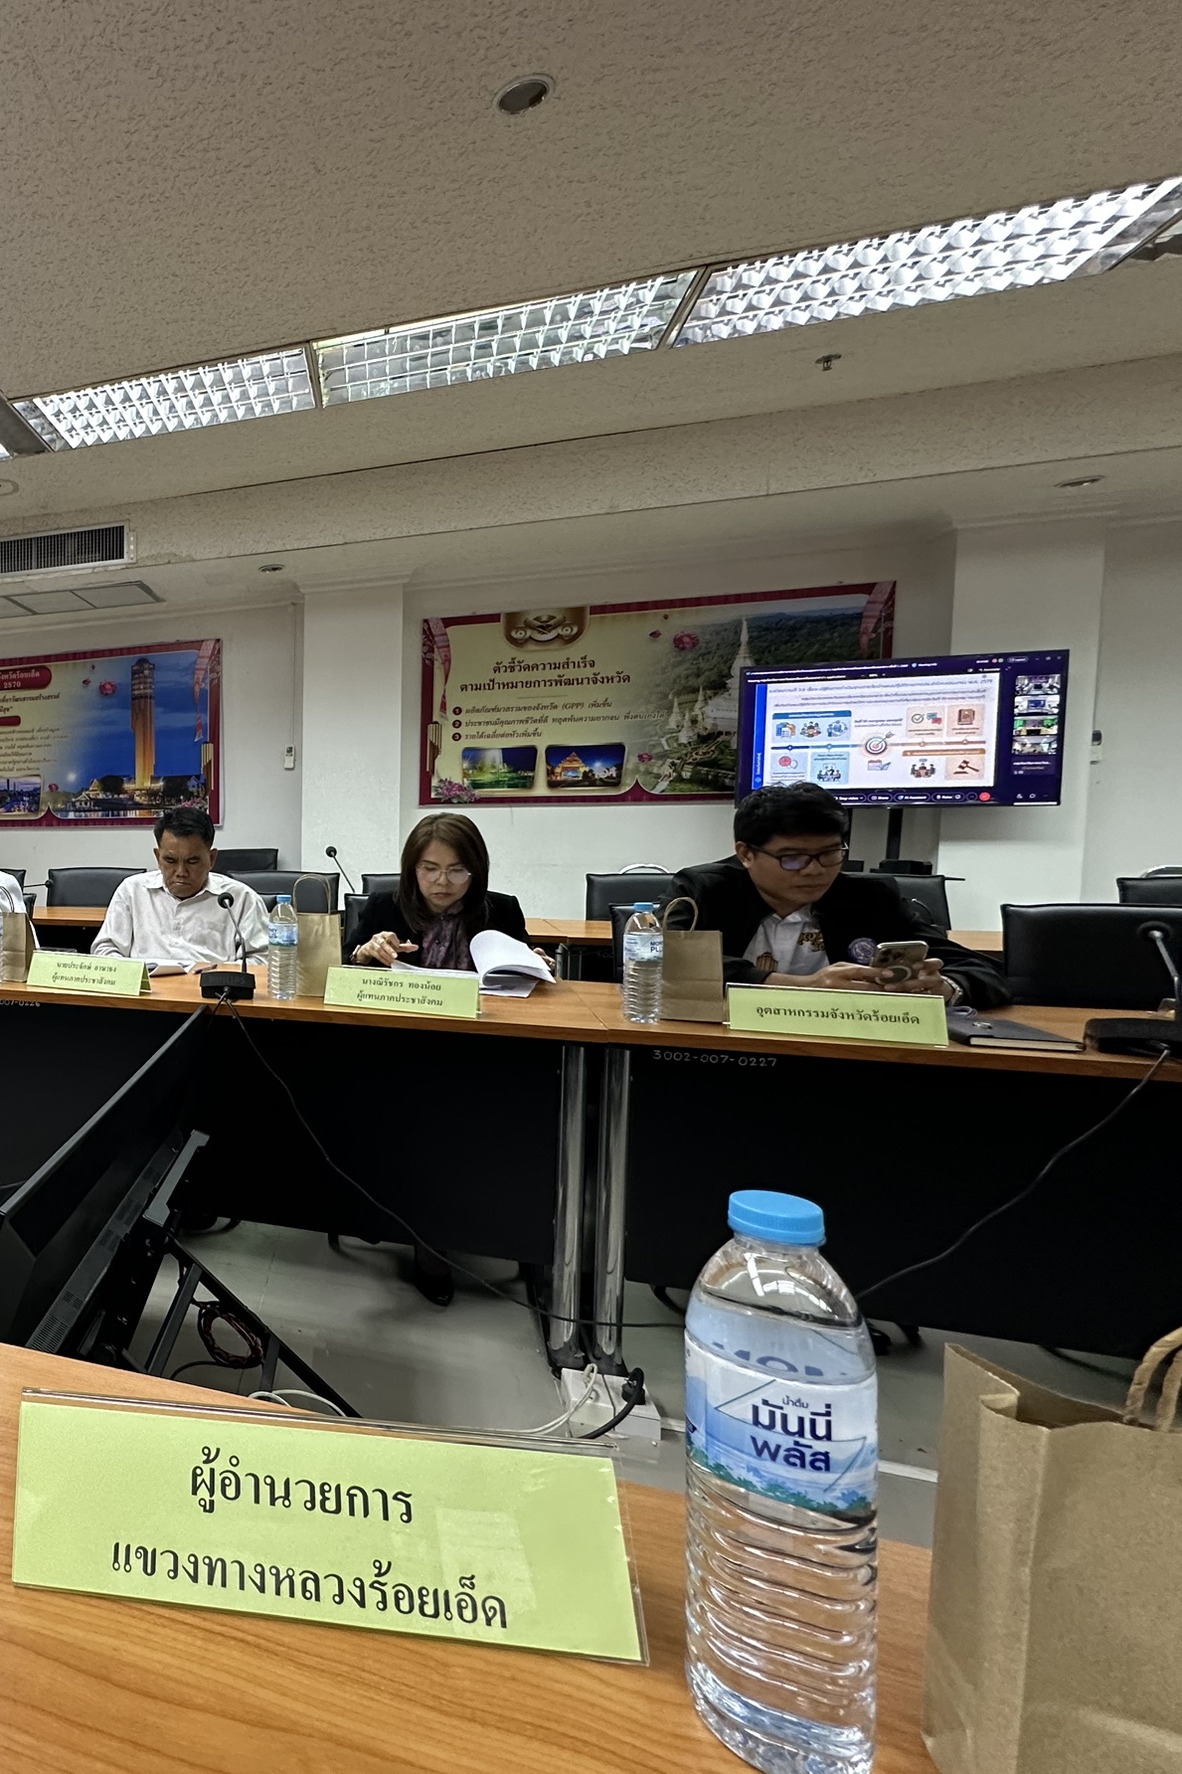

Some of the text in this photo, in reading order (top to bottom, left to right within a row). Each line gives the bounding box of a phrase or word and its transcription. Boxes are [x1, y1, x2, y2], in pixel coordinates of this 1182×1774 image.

[492, 655, 596, 675] ตัวชี้วัดความสำเร็จ
[459, 671, 631, 692] ตามเป้าหมายการพัฒนาจังหวัด
[408, 980, 442, 991] ทองน้อย
[357, 990, 443, 1006] ผู้แทนภาคประชาสังคม
[755, 1004, 921, 1026] อุตสาหกรรมจังหวัดร้อยเอ็ด
[652, 1049, 778, 1068] 3002-007-0227
[782, 1396, 809, 1409] น้ำดื่ม
[751, 1398, 832, 1441] มันนี่
[750, 1435, 832, 1473] พลัส
[189, 1445, 414, 1525] ผู้อำนวยการ
[111, 1540, 508, 1631] แขวงทางหลวงร้อยเอ็ด
